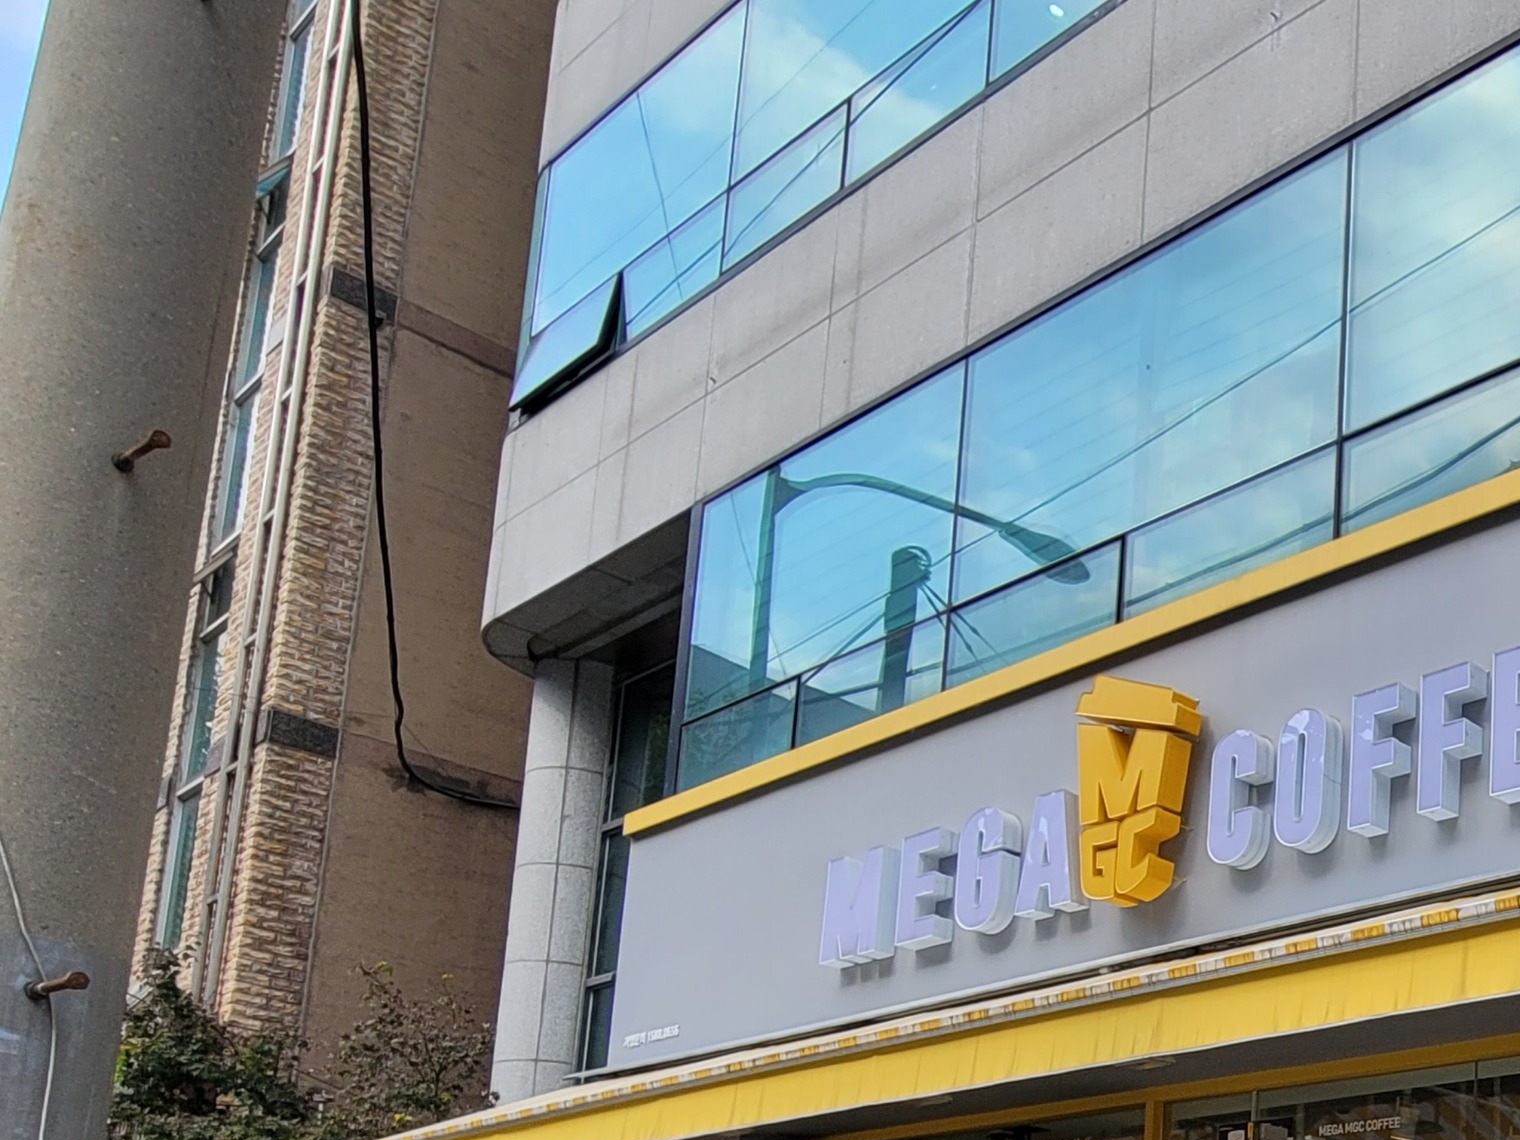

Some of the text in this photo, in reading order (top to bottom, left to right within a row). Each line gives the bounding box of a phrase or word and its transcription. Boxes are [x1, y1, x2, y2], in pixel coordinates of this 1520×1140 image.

[818, 790, 1088, 969] MEGA
[1318, 1116, 1401, 1137] MEGA MGC COFFEE
